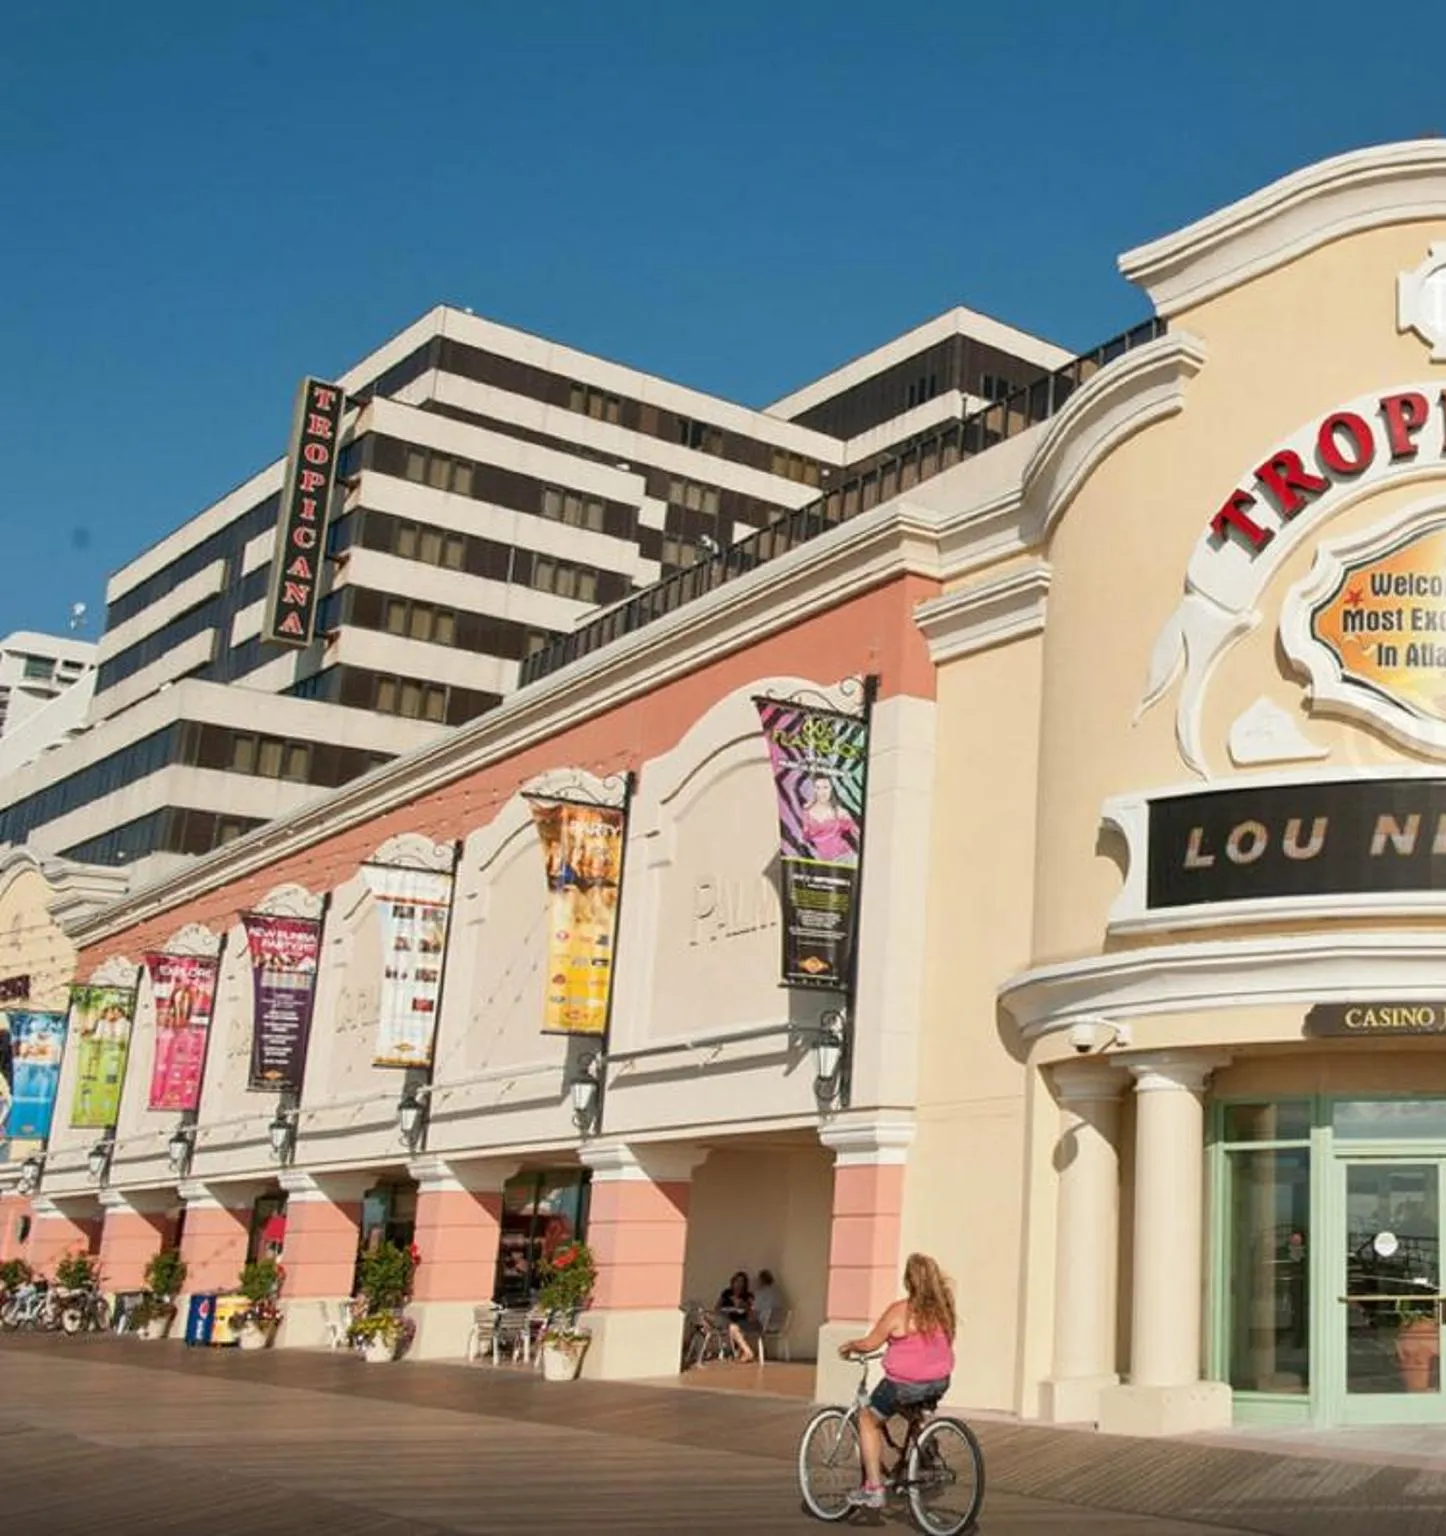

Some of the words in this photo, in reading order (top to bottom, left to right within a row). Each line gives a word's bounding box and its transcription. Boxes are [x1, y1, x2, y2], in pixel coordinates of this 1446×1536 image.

[278, 386, 336, 635] TROPICANA
[1342, 608, 1404, 633] Most
[1376, 643, 1398, 668] In
[1184, 816, 1329, 869] LOU
[1344, 1007, 1436, 1028] CASINO
